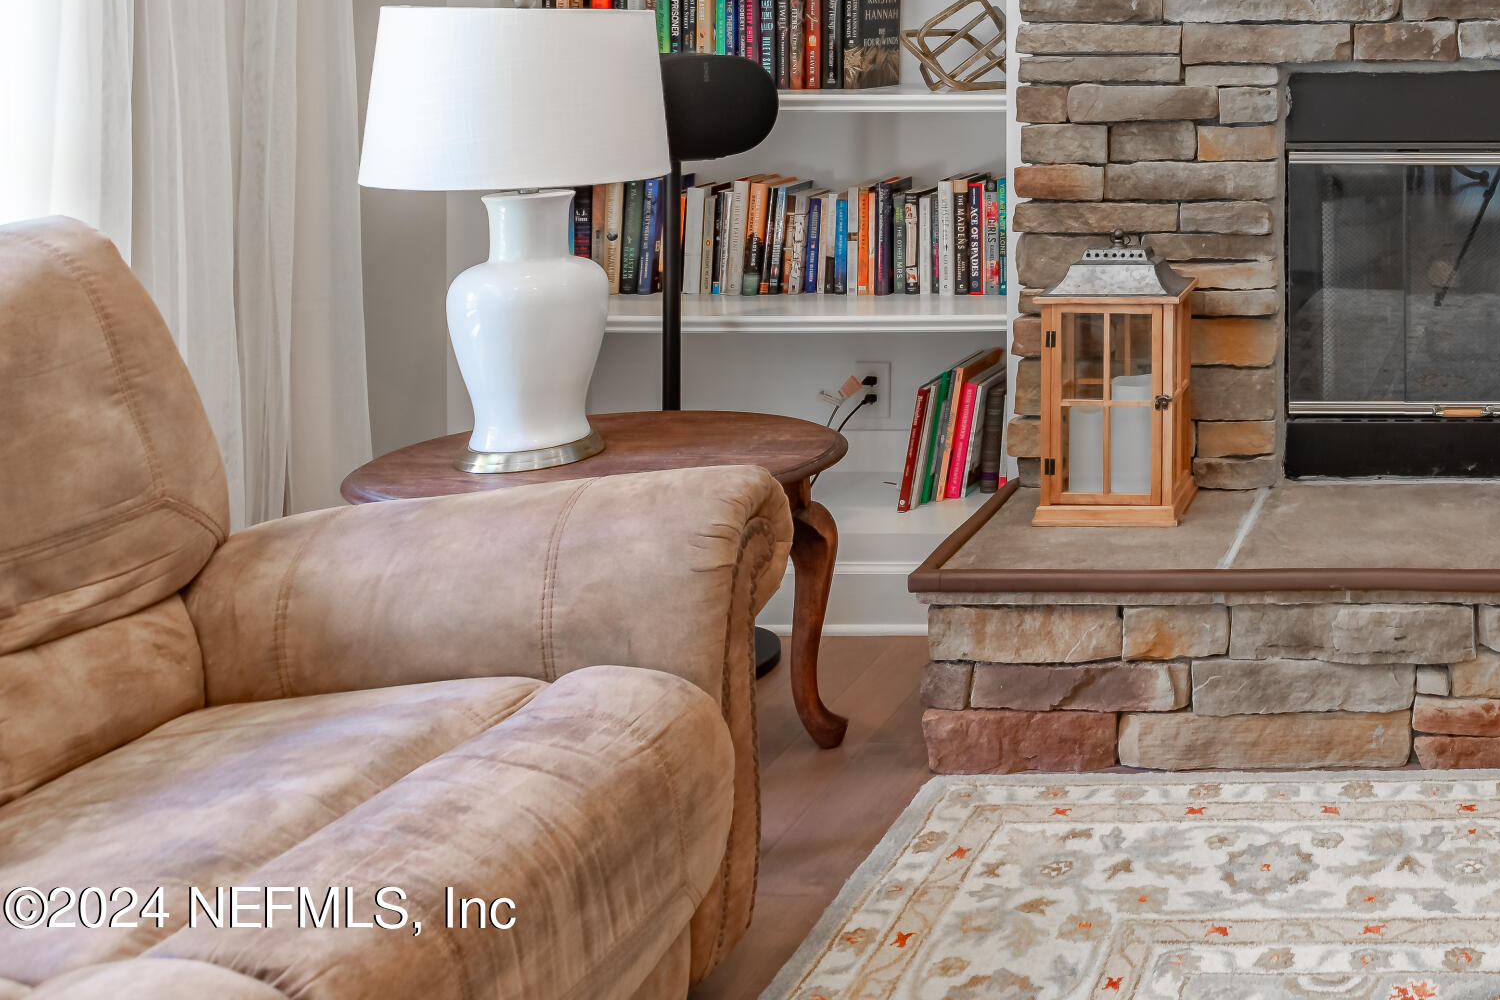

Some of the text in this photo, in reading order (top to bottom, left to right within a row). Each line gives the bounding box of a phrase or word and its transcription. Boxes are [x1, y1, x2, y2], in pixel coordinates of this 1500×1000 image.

[671, 0, 679, 36] PRISONER
[778, 1, 786, 30] JEWELL
[865, 8, 899, 20] HANNAH
[763, 37, 771, 56] RILEY
[864, 37, 898, 47] FOUR WINDS
[970, 206, 979, 225] ACE
[971, 227, 979, 239] OF
[987, 217, 997, 243] GIRLS
[970, 241, 979, 277] SPADES
[960, 404, 970, 439] WITHERSPOON
